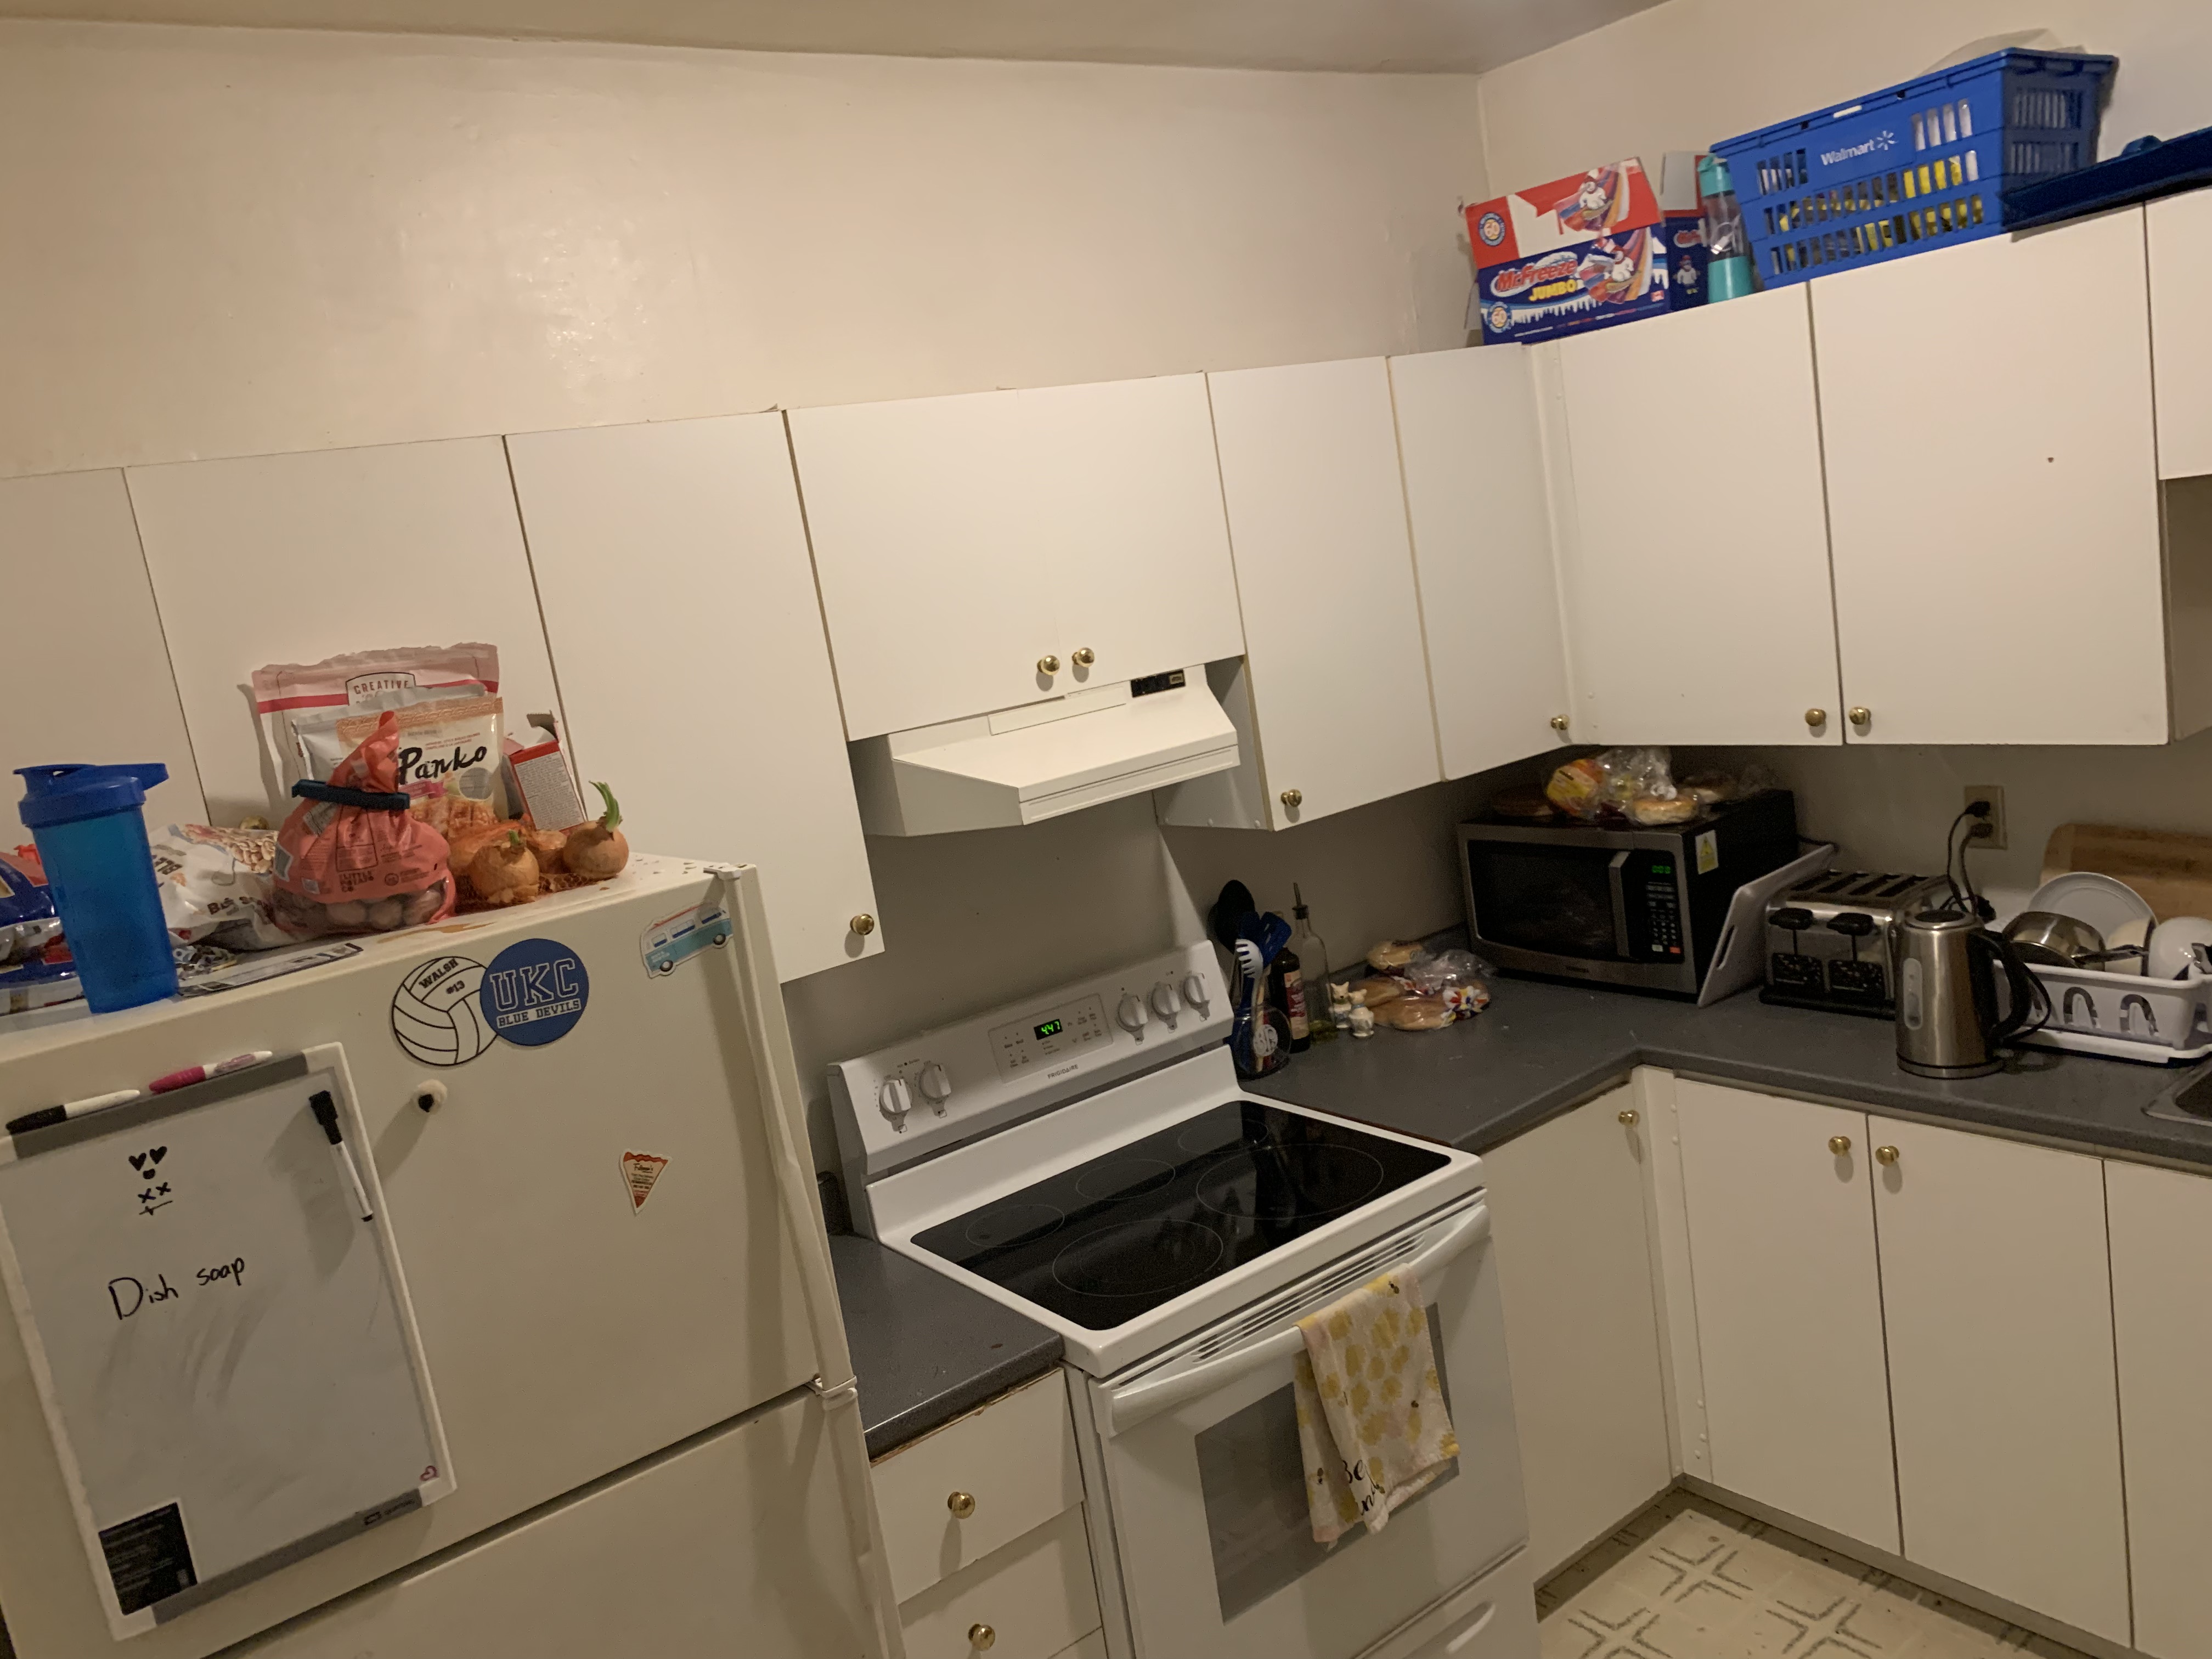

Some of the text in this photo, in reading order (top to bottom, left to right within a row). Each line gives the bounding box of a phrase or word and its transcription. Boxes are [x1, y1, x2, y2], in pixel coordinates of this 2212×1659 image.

[1820, 139, 1875, 166] Walmart
[1484, 222, 1500, 237] 60
[1528, 279, 1577, 301] JUMBO
[353, 680, 409, 694] CREATIVE
[398, 746, 487, 785] Panko
[419, 958, 459, 988] WALSH
[489, 958, 579, 1011] UKC
[446, 980, 465, 994] #13
[498, 1000, 579, 1026] BLUE DEVILS
[1047, 1064, 1079, 1079] FRIGIDAIRE
[108, 1257, 245, 1320] Dish soap
